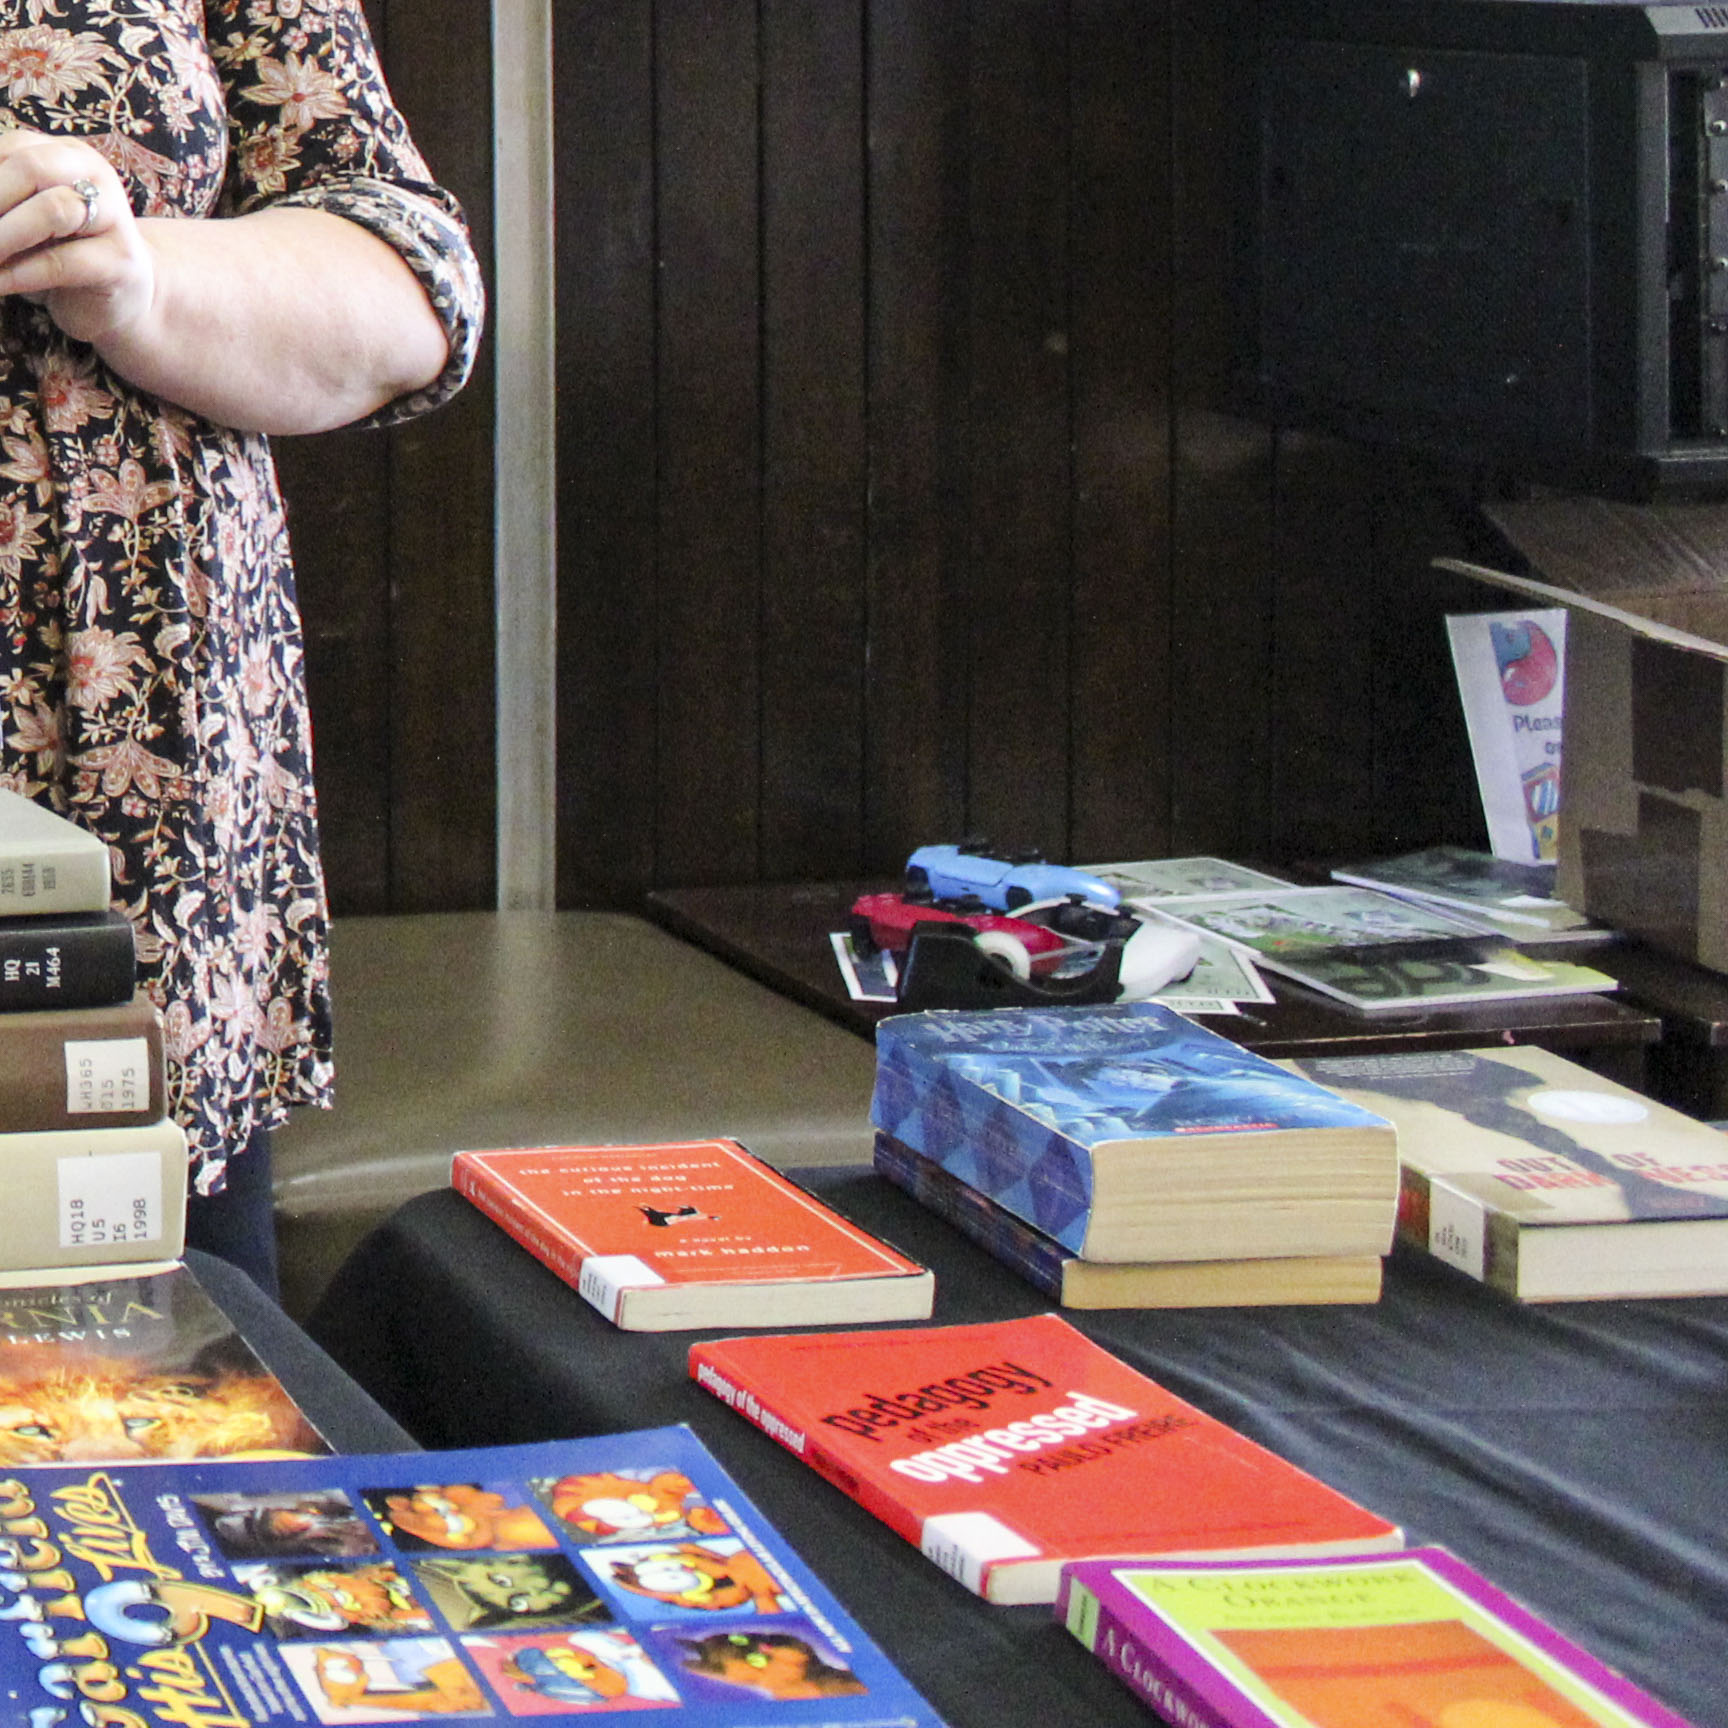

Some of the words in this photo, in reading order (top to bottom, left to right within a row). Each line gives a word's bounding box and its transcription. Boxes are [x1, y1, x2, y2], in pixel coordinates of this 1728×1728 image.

[4, 959, 21, 982] HQ
[26, 962, 41, 976] 21
[46, 947, 62, 989] M464
[519, 1167, 550, 1175] the
[640, 1161, 722, 1172] incident
[654, 1248, 713, 1257] mark
[722, 1244, 811, 1255] haddon
[8, 1328, 131, 1345] LEWIS
[820, 1359, 1055, 1443] pedagogy
[889, 1390, 1140, 1484] oppressed
[1019, 1443, 1106, 1478] PAULO
[1103, 1415, 1201, 1458] FREIRE
